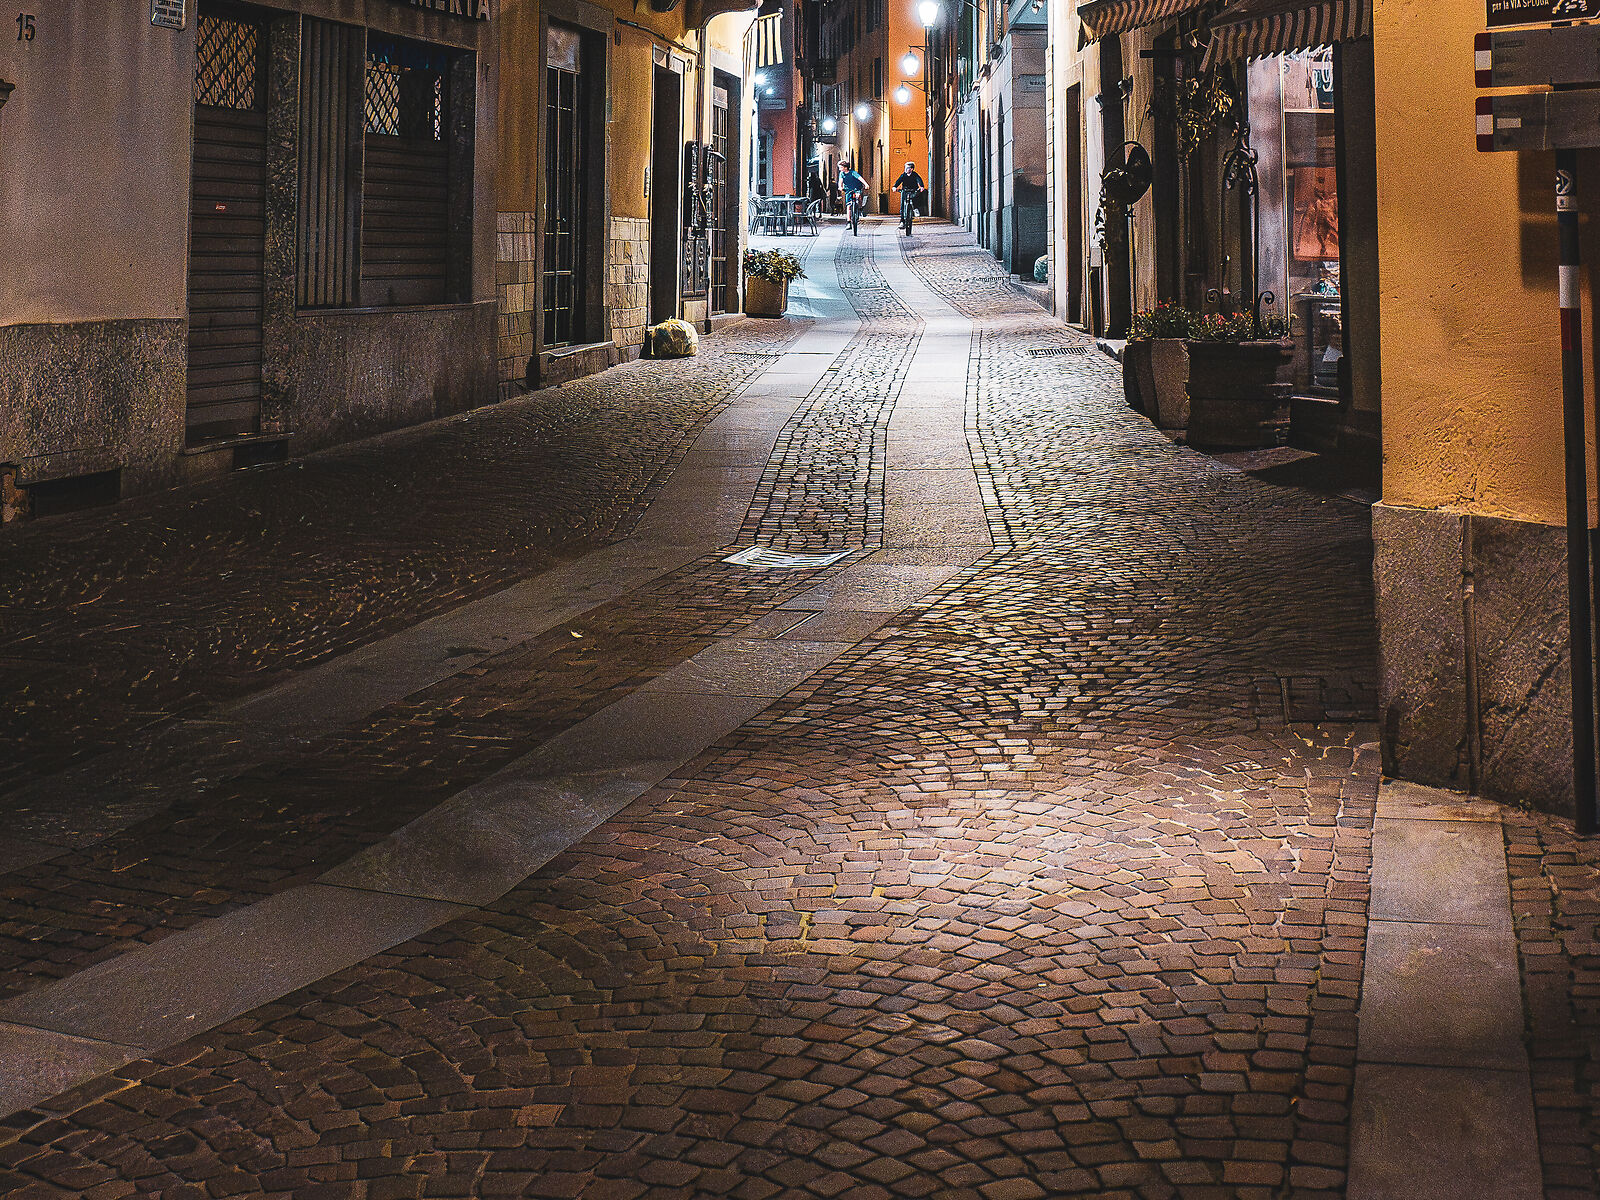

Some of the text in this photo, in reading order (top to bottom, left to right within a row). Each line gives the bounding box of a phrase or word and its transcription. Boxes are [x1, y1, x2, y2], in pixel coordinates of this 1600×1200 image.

[1503, 0, 1510, 11] la
[16, 12, 36, 41] 15
[686, 58, 693, 73] 21
